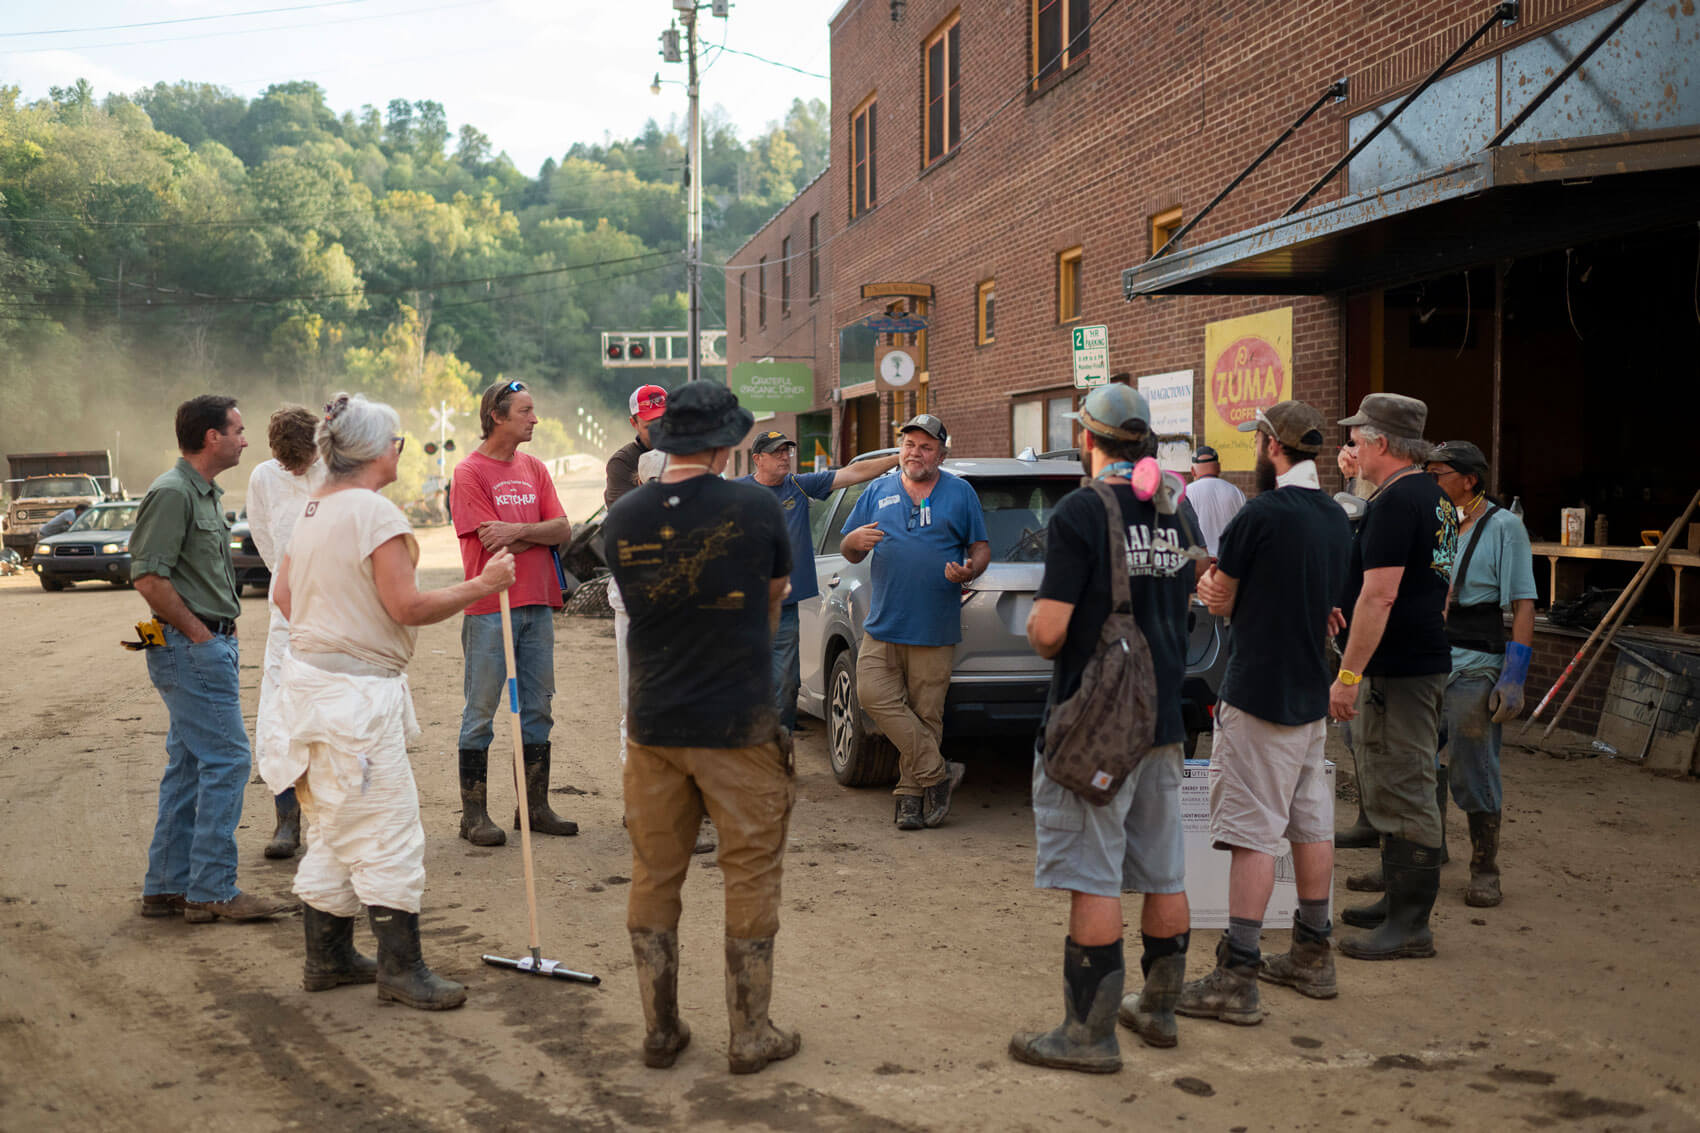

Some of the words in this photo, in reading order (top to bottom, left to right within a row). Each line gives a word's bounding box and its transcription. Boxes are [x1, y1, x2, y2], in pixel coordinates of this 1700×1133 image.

[1076, 332, 1082, 347] 2
[1215, 365, 1278, 406] ZUMA
[1230, 407, 1260, 421] COFFE
[495, 494, 537, 505] KETCHUP
